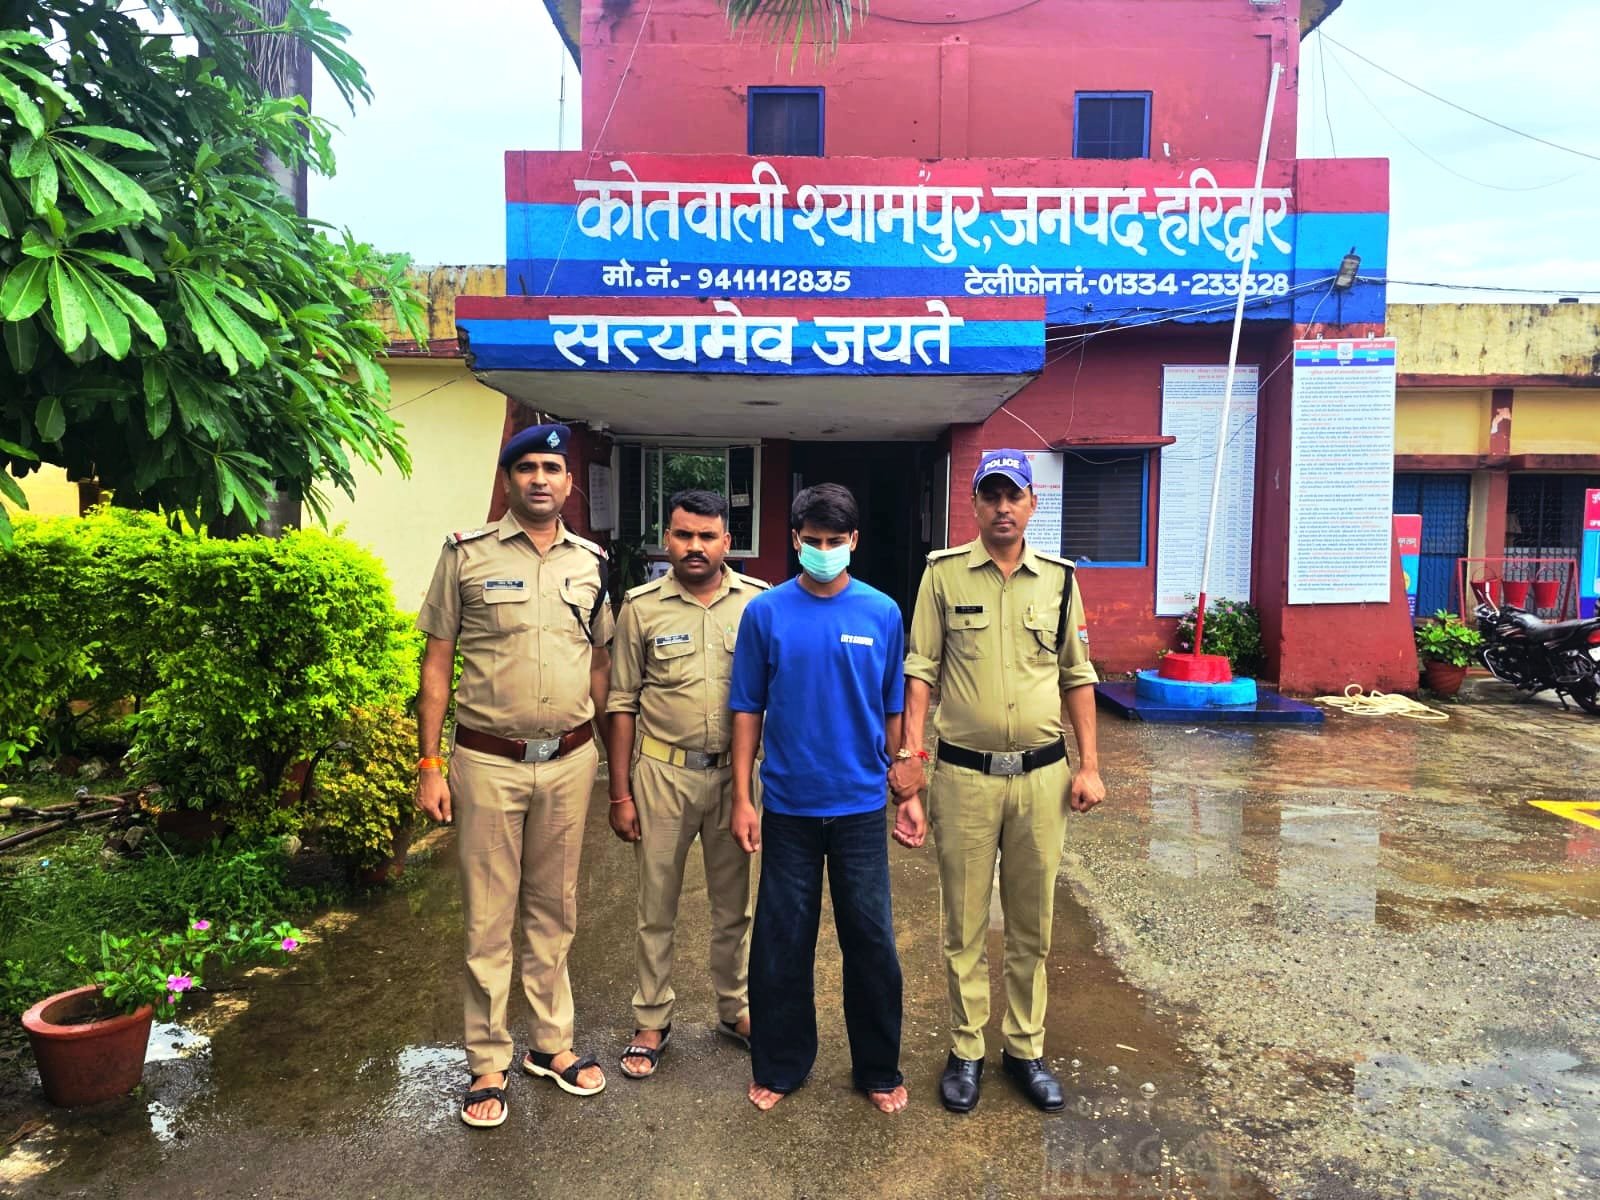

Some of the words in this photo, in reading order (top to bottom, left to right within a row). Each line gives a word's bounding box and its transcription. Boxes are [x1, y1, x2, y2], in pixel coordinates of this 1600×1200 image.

[573, 161, 789, 244] कोतवाली
[698, 267, 851, 292] 9411112835
[548, 300, 799, 367] सत्यमेव
[811, 299, 965, 366] जयते
[984, 458, 1020, 471] POLICE
